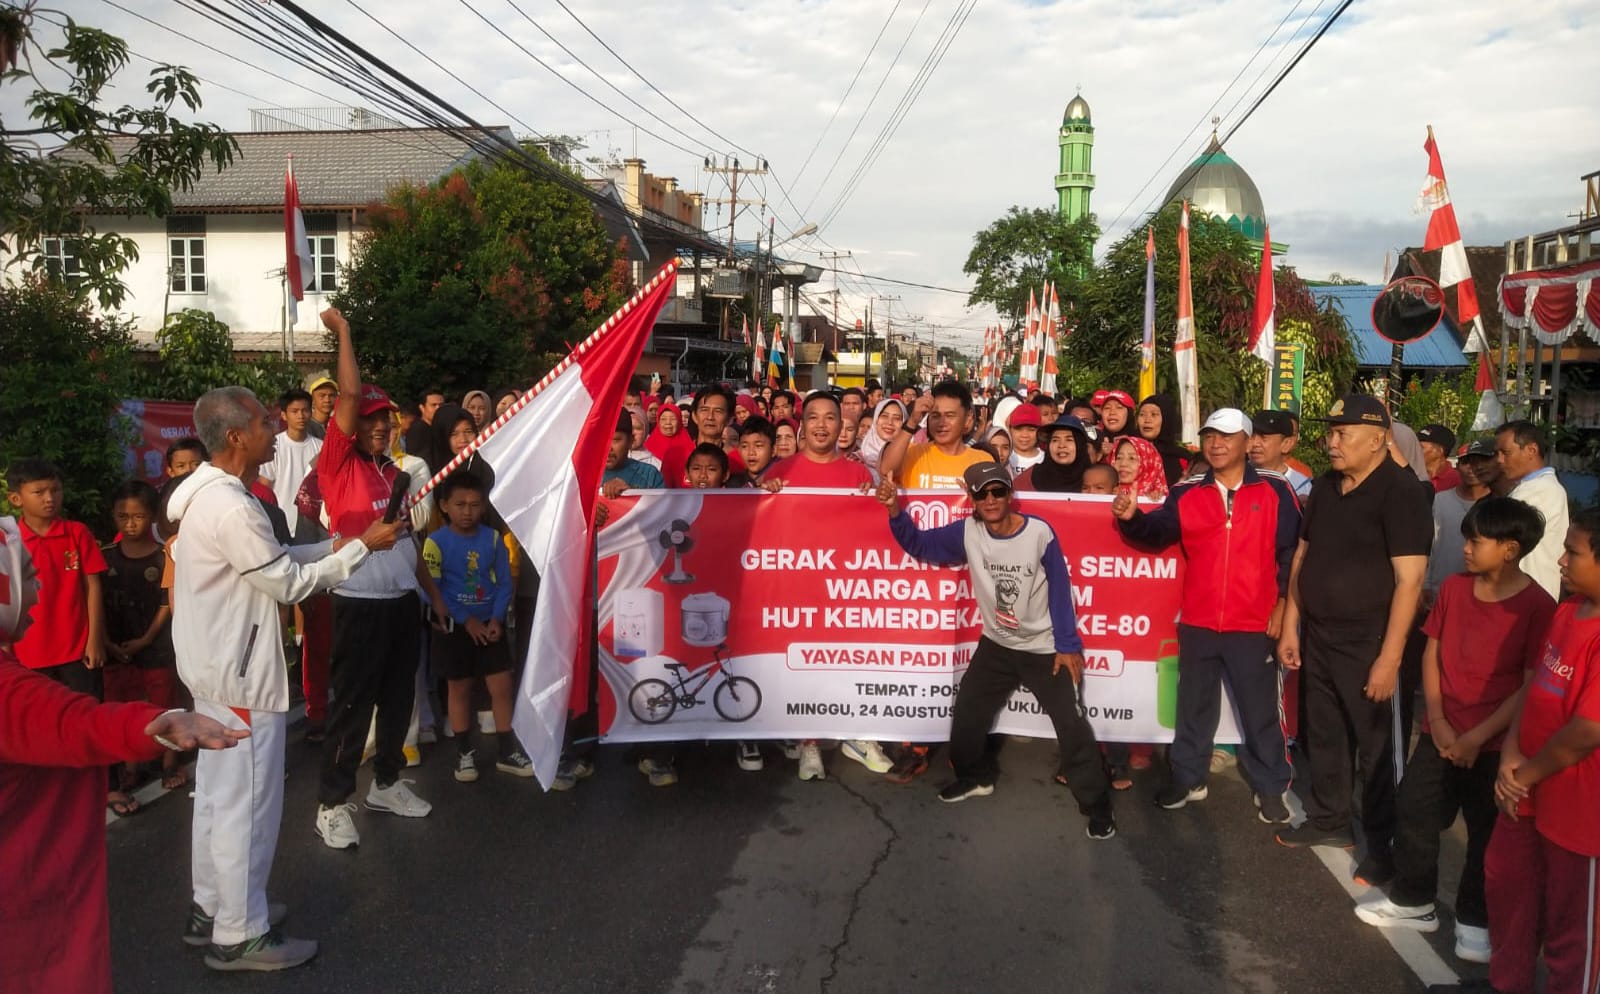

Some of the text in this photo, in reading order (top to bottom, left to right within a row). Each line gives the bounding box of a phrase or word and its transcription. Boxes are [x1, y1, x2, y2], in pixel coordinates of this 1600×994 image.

[951, 505, 974, 514] Bersa
[740, 549, 836, 571] GERAK
[1080, 556, 1176, 580] SENAM
[990, 564, 1022, 572] DIKLAT
[826, 579, 930, 600] WARGA
[762, 606, 1150, 636] HUT KEMERDEKA KE-80
[800, 650, 895, 666] YAYASAN
[900, 650, 946, 667] PADI
[952, 648, 971, 666] NIL
[855, 682, 918, 697] TEMPAT
[930, 684, 960, 698] POS
[786, 703, 855, 718] MINGGU,
[859, 704, 878, 716] 24
[882, 706, 956, 718] AGUSTUS
[1008, 700, 1052, 715] UKUL
[1103, 708, 1134, 720] WIB
